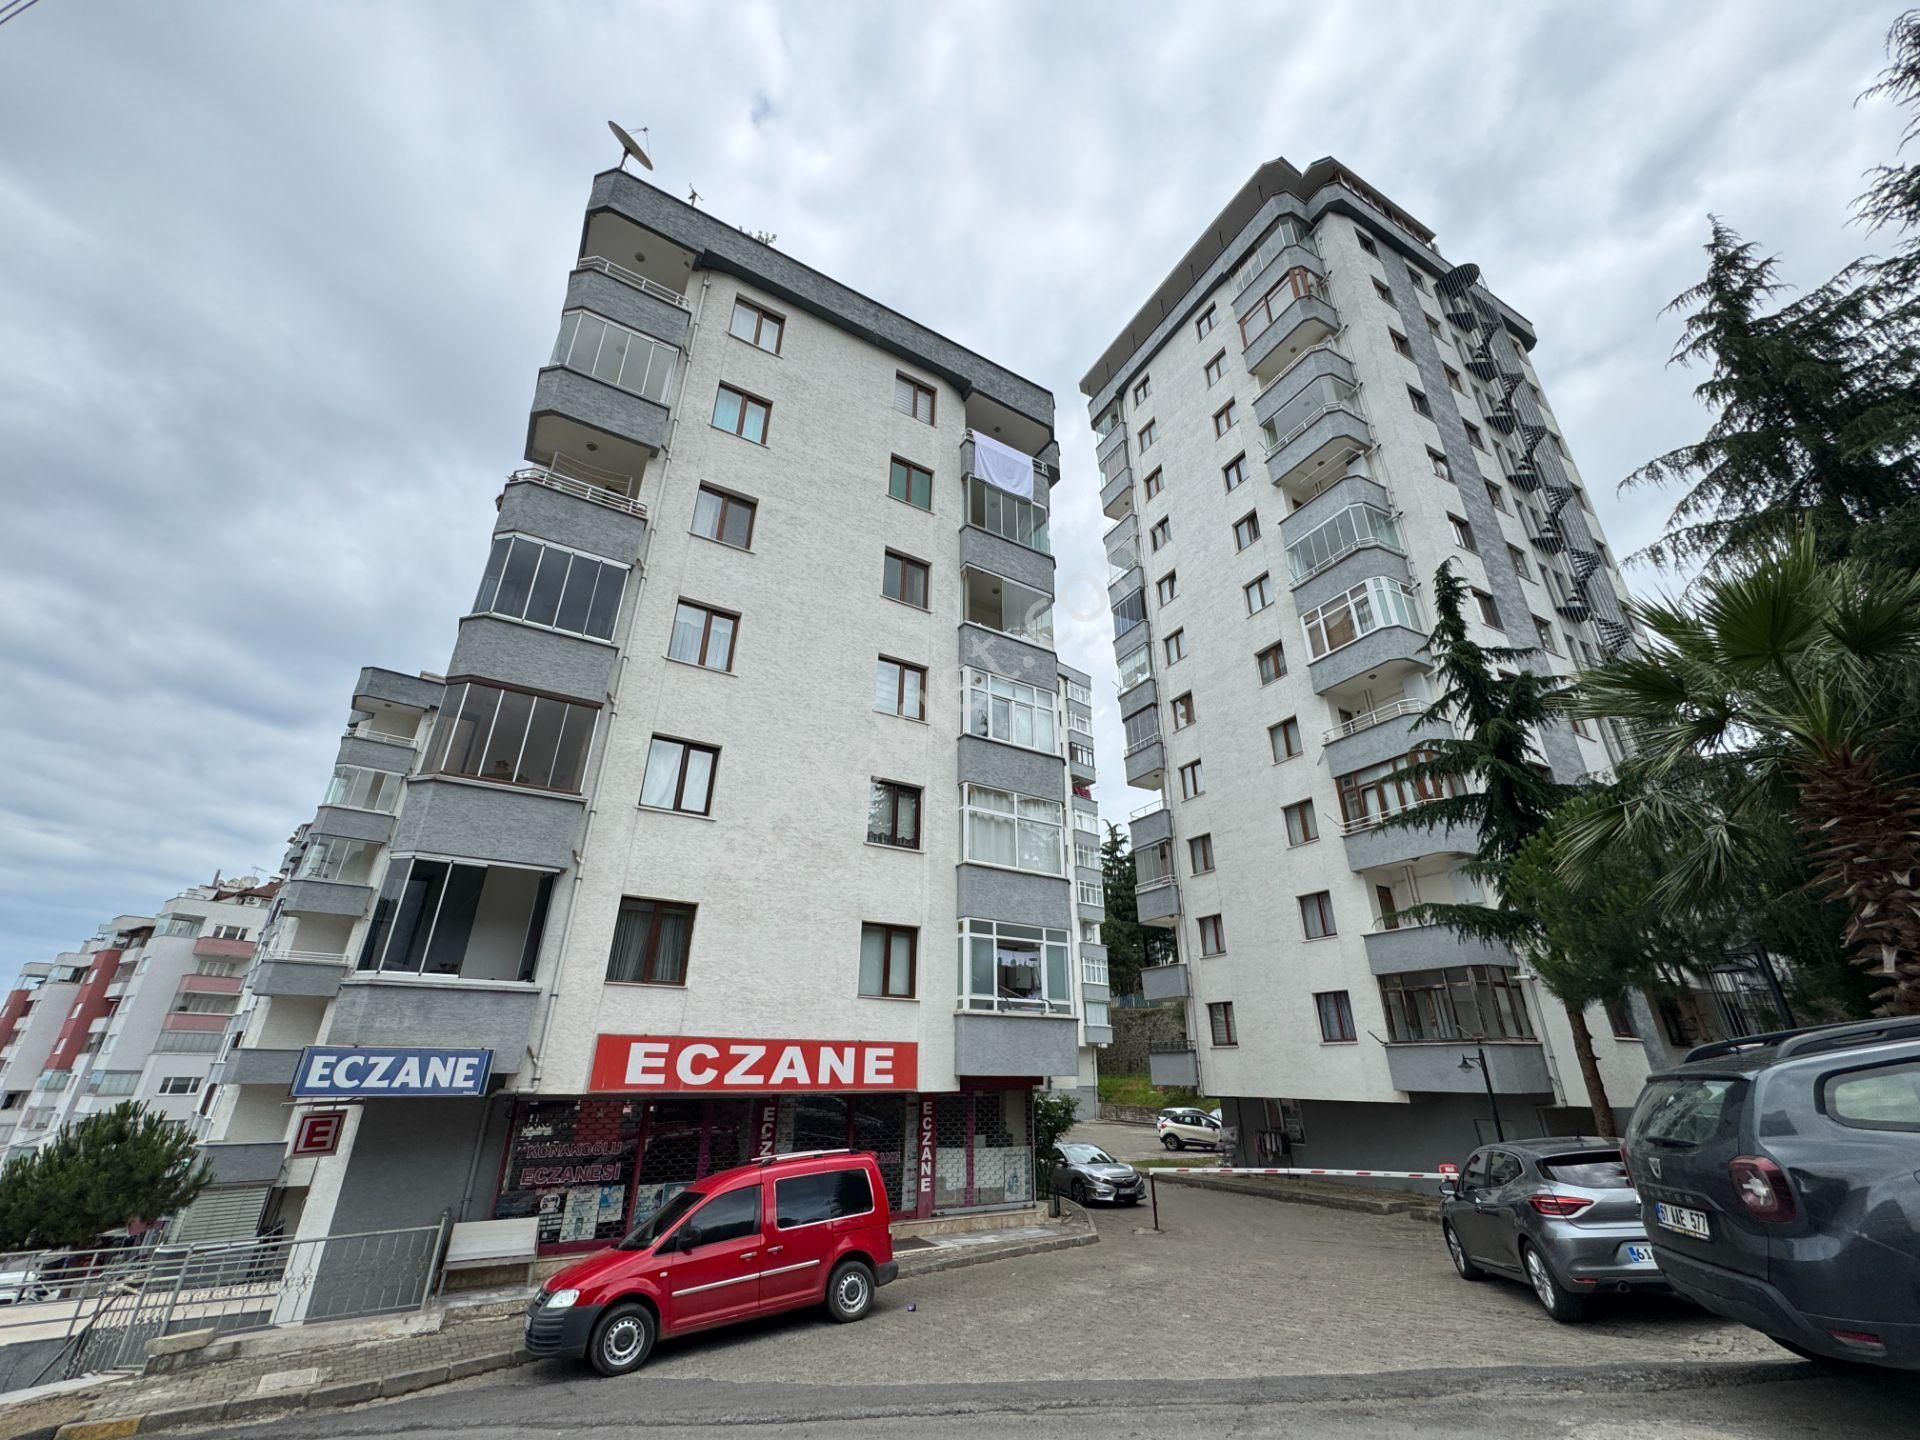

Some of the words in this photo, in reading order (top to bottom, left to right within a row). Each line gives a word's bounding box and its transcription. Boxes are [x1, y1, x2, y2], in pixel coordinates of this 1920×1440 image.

[304, 1055, 480, 1089] ECZANE
[624, 1042, 894, 1085] ECZANE
[302, 1120, 333, 1149] E
[759, 1106, 776, 1157] ECZ
[920, 1101, 933, 1192] ECZANE
[1689, 1211, 1706, 1232] 577
